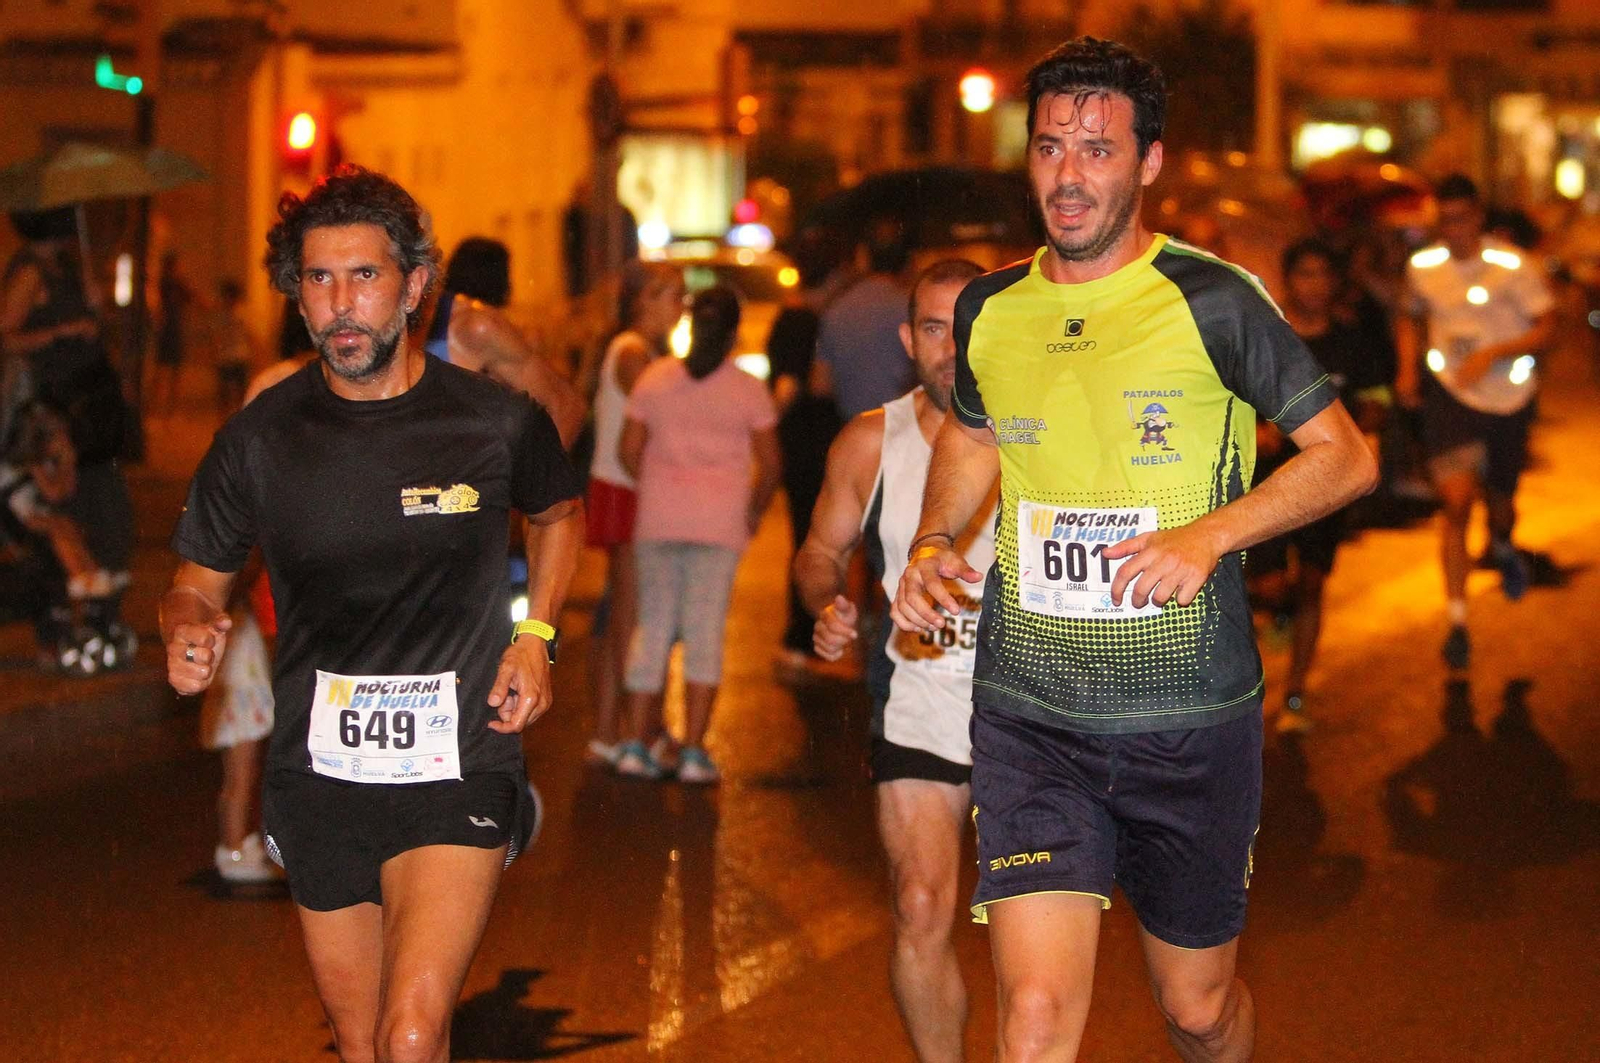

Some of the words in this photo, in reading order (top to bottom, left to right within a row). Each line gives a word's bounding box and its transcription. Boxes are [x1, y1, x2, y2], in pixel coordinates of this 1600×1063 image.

[1123, 389, 1184, 399] PATAPALOS
[999, 415, 1047, 431] CLÍNICA
[1000, 432, 1041, 444] RAGEL
[1131, 453, 1182, 466] HUELVA
[1054, 512, 1140, 527] NOCTURNA
[1051, 526, 1072, 540] DE
[1075, 527, 1137, 542] HUELVA
[1043, 540, 1111, 583] 601
[1066, 582, 1089, 591] ISRAEL
[354, 679, 441, 695] NOCTURNA
[350, 695, 373, 709] DE
[377, 694, 438, 709] HUELVA
[339, 709, 416, 750] 649
[391, 771, 423, 779] SportJobs
